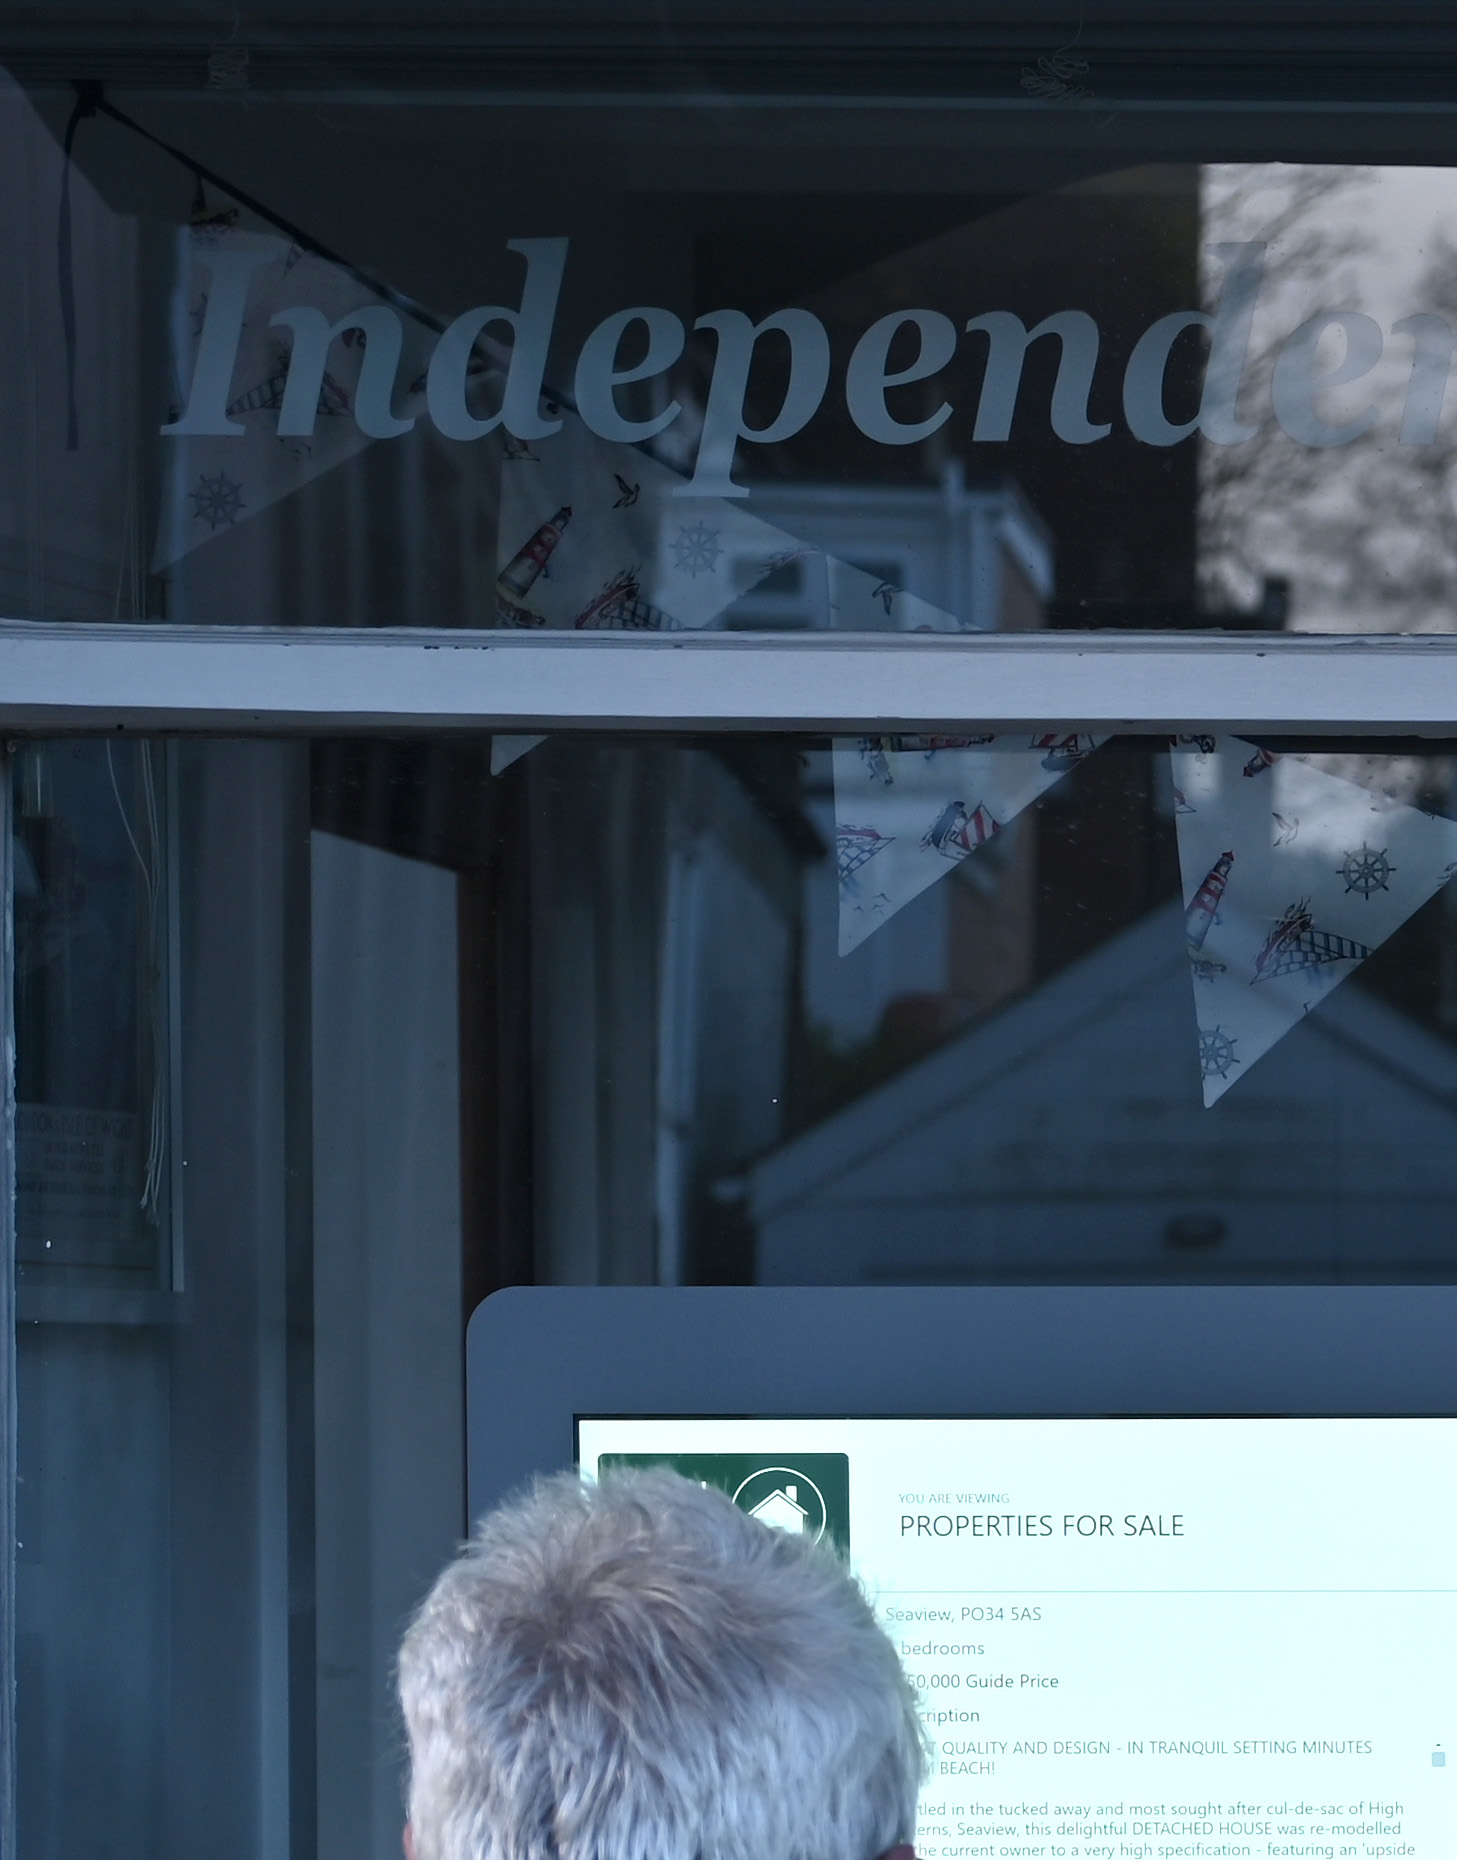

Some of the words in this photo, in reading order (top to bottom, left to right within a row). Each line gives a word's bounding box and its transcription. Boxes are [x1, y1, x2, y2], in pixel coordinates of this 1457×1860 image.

[897, 1492, 925, 1504] YOU
[927, 1493, 949, 1504] ARE
[954, 1492, 1010, 1504] VIEWING
[900, 1514, 1053, 1537] PROPERTIES
[1063, 1514, 1115, 1537] FOR
[1123, 1514, 1185, 1537] SALE
[884, 1606, 956, 1625] Seaview,
[961, 1606, 1004, 1621] PO34
[1010, 1606, 1042, 1621] 5AS
[901, 1641, 985, 1656] bedrooms
[965, 1673, 1014, 1689] Guide
[1020, 1673, 1059, 1688] Price
[939, 1760, 995, 1775] BEACH!
[951, 1805, 965, 1816] in
[969, 1801, 994, 1816] the
[998, 1801, 1048, 1816] tucked
[1053, 1805, 1092, 1819] away
[1095, 1801, 1124, 1816] and
[1128, 1803, 1166, 1816] most
[1170, 1800, 1223, 1819] sought
[1227, 1800, 1262, 1815] after
[1266, 1800, 1344, 1815] cul-de-sac
[1348, 1800, 1365, 1815] of
[1368, 1800, 1404, 1819] High
